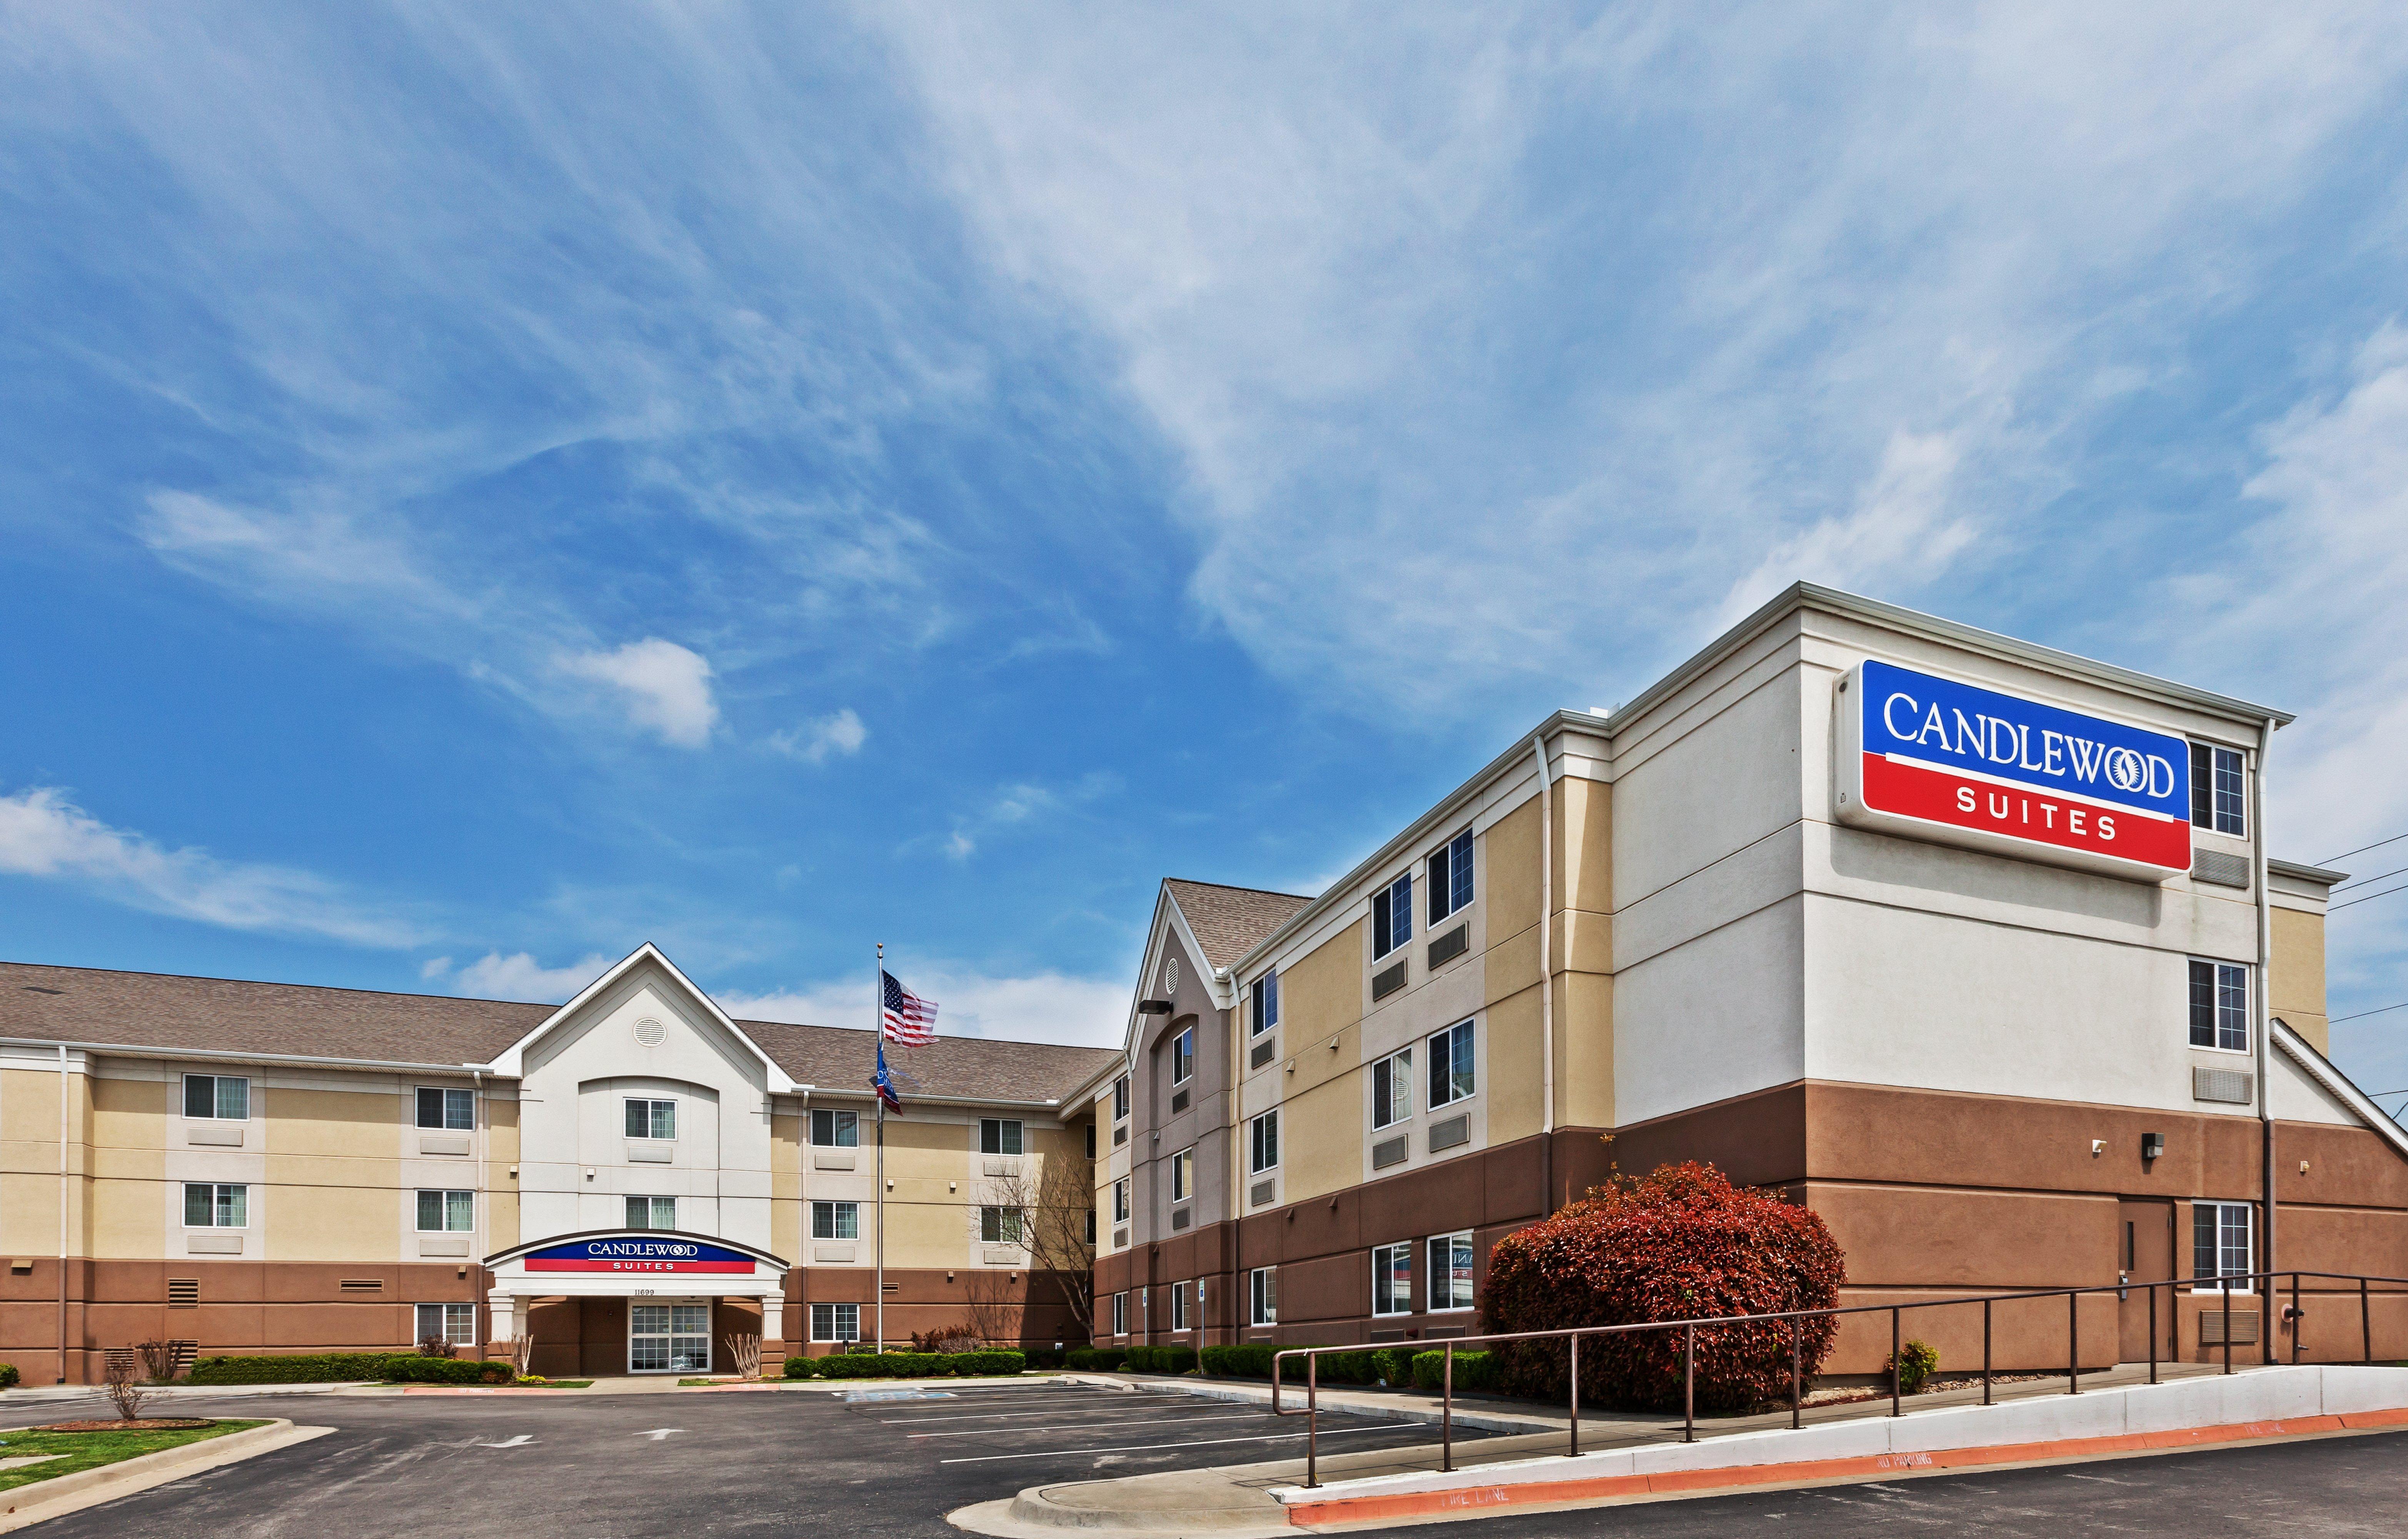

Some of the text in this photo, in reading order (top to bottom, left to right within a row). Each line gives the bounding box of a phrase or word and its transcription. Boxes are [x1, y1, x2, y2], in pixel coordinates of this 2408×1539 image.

[1884, 693, 2175, 798] CANDLEWOOD
[1956, 786, 2116, 840] SUITES
[588, 1243, 698, 1256] CANDLEWOOD
[1876, 1452, 1932, 1468] NO PARKING
